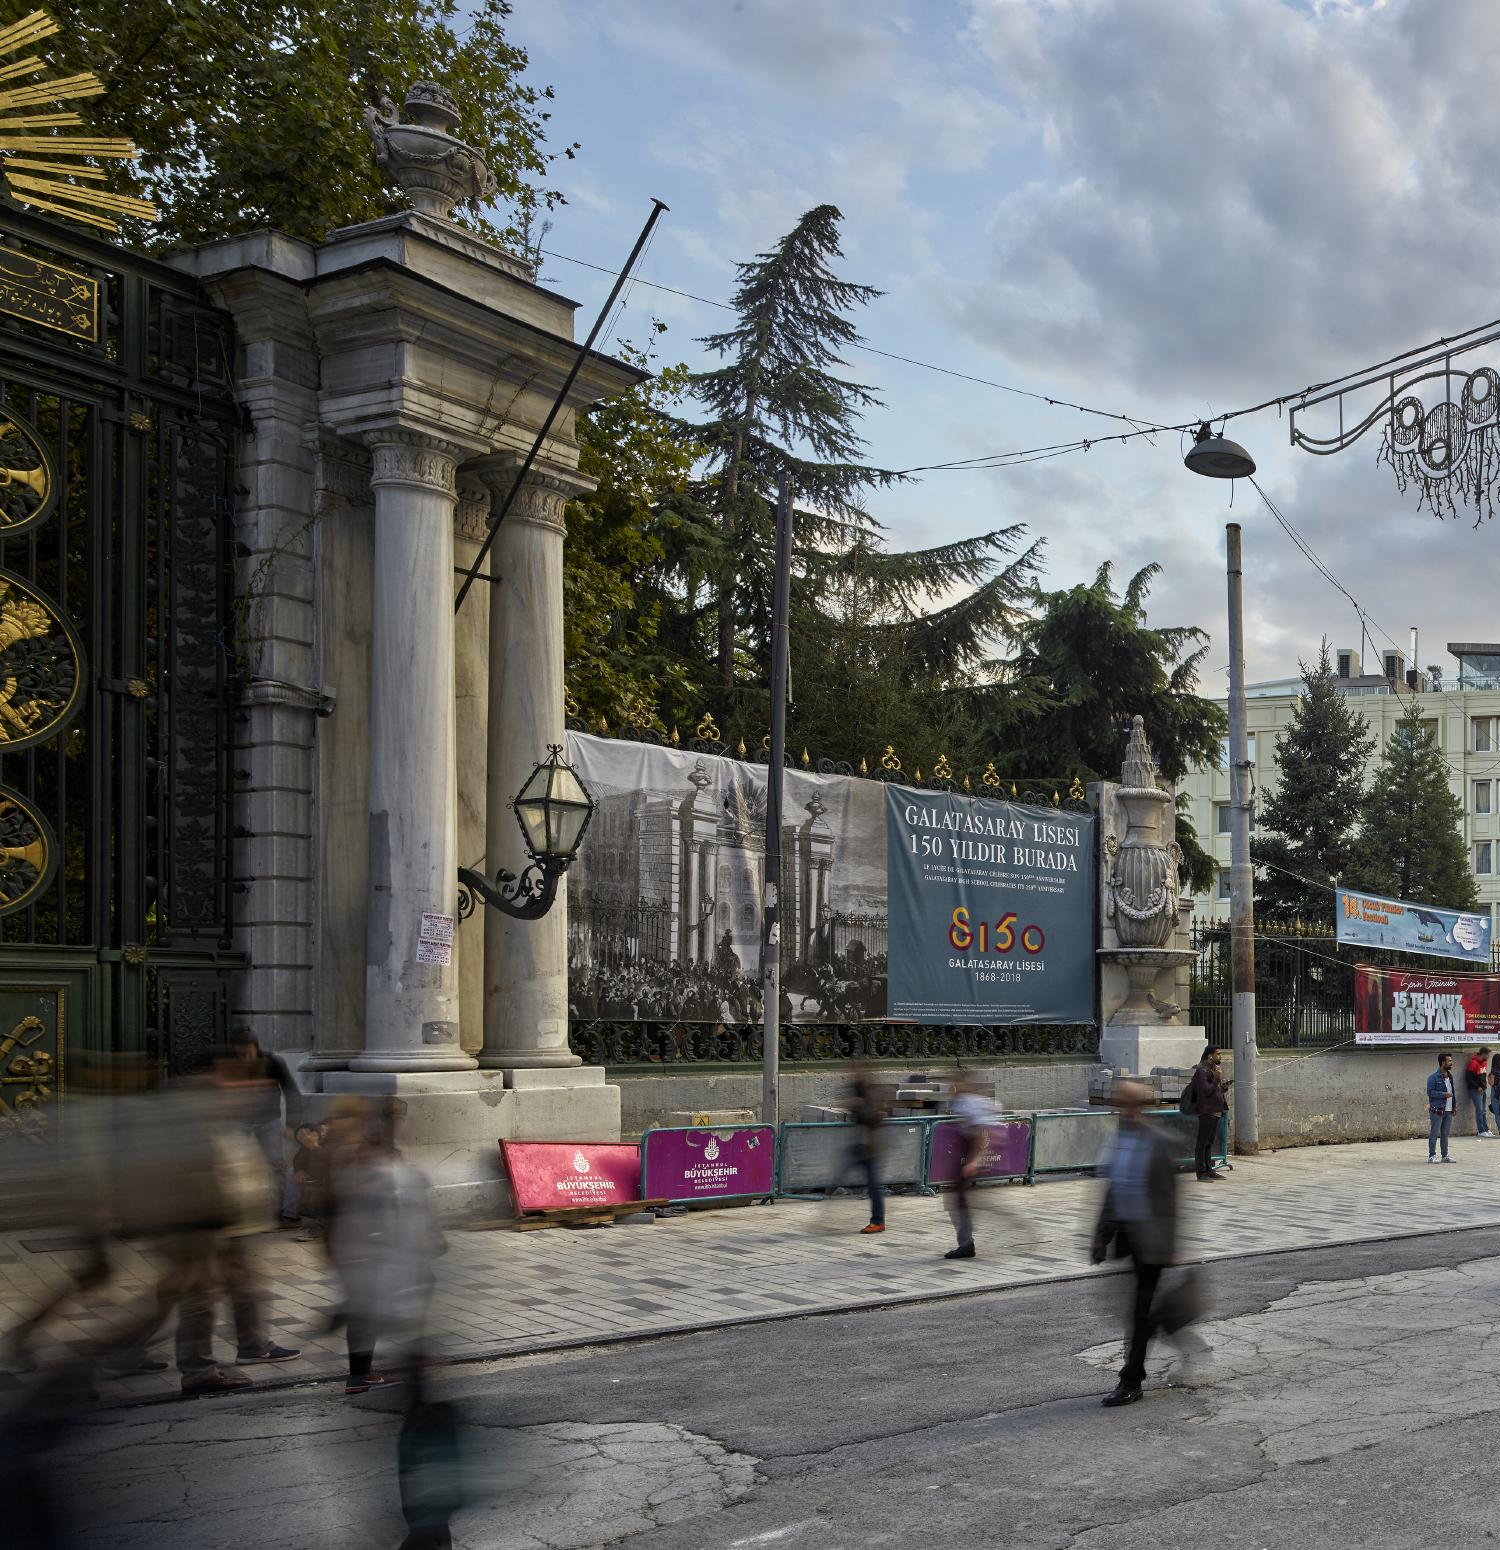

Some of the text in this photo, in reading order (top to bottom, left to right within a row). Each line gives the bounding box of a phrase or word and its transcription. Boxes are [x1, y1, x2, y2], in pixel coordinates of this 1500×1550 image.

[905, 805, 1080, 847] GALATASARAY LİSESİ
[910, 834, 1078, 872] 150 YILDIR BURADA
[956, 867, 989, 877] GALATASARAY
[924, 875, 958, 884] GALATASARAY
[948, 958, 1045, 971] GALATASARAY LİSESİ
[975, 972, 1021, 982] 1868-2018
[1393, 991, 1463, 1010] 15 TEMMUZ
[1392, 1007, 1466, 1031] DESTANI
[684, 1165, 738, 1179] BÜYÜKŞEHİR
[556, 1179, 616, 1193] BÜYÜKŞEHİR
